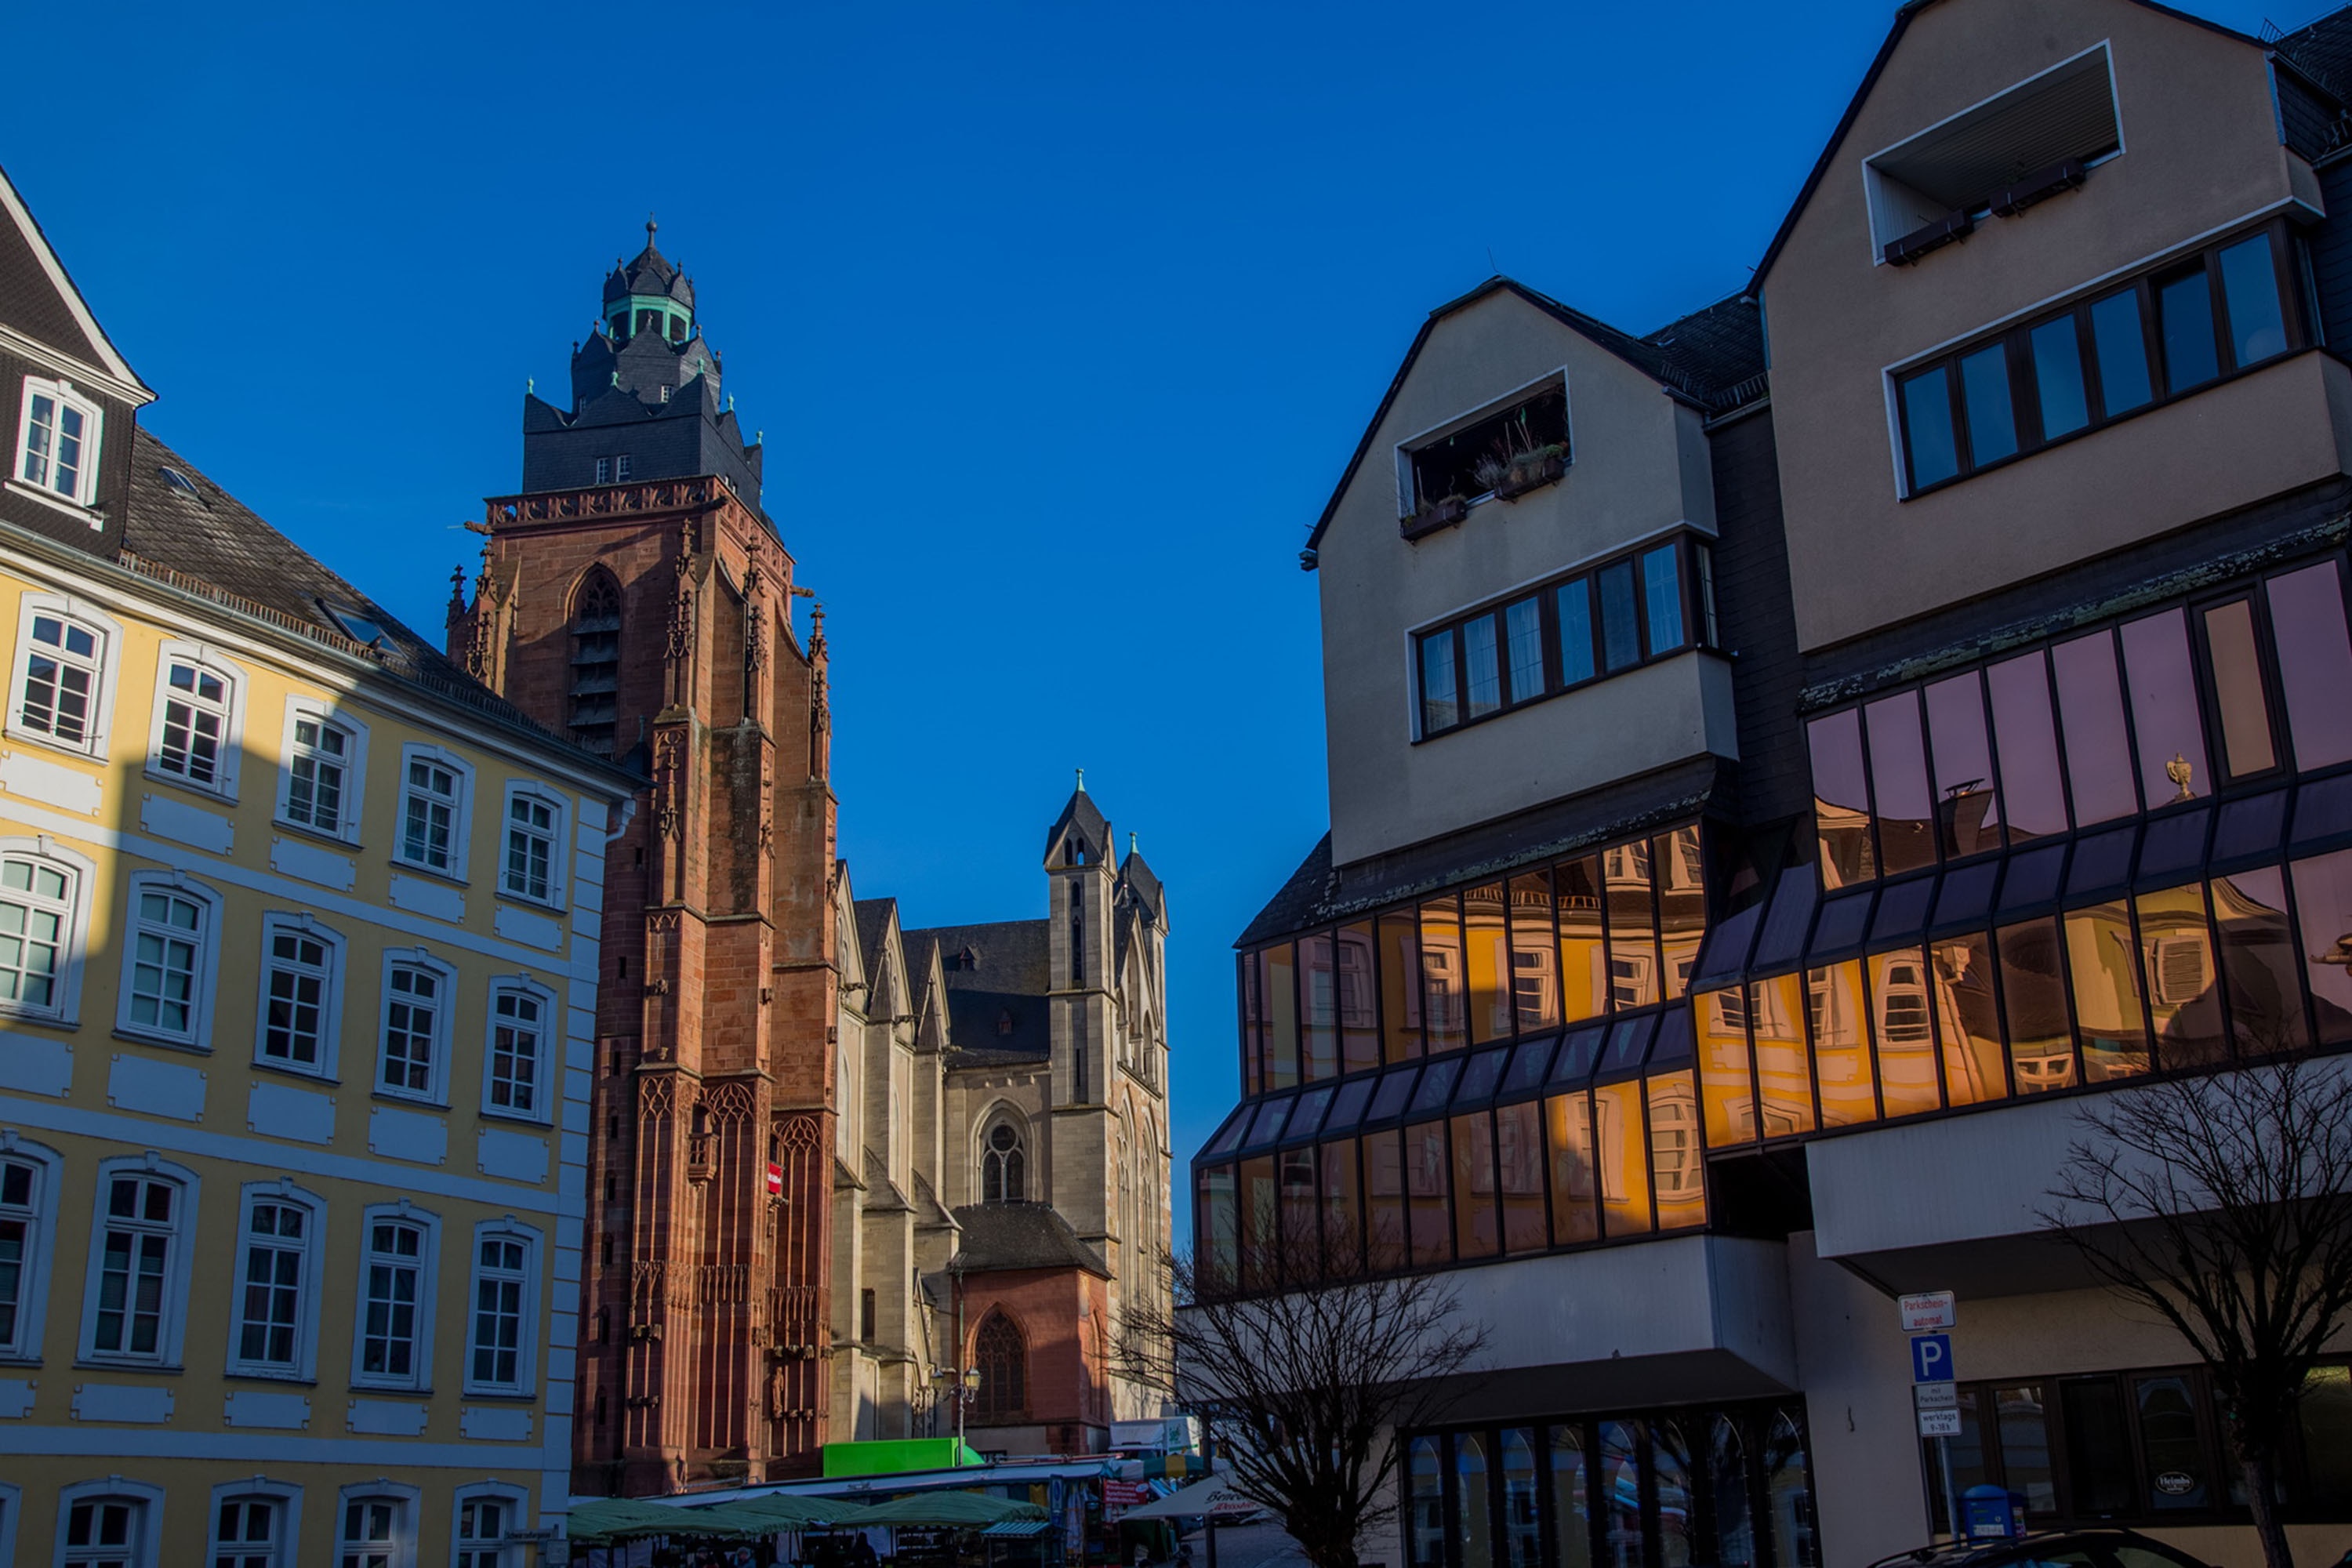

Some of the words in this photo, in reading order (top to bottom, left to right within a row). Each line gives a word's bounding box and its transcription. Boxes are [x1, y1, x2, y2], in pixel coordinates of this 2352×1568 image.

[1904, 1300, 1948, 1311] Parkschein-
[1913, 1315, 1944, 1327] automat
[1920, 1341, 1942, 1377] P
[1922, 1413, 1956, 1422] werktags
